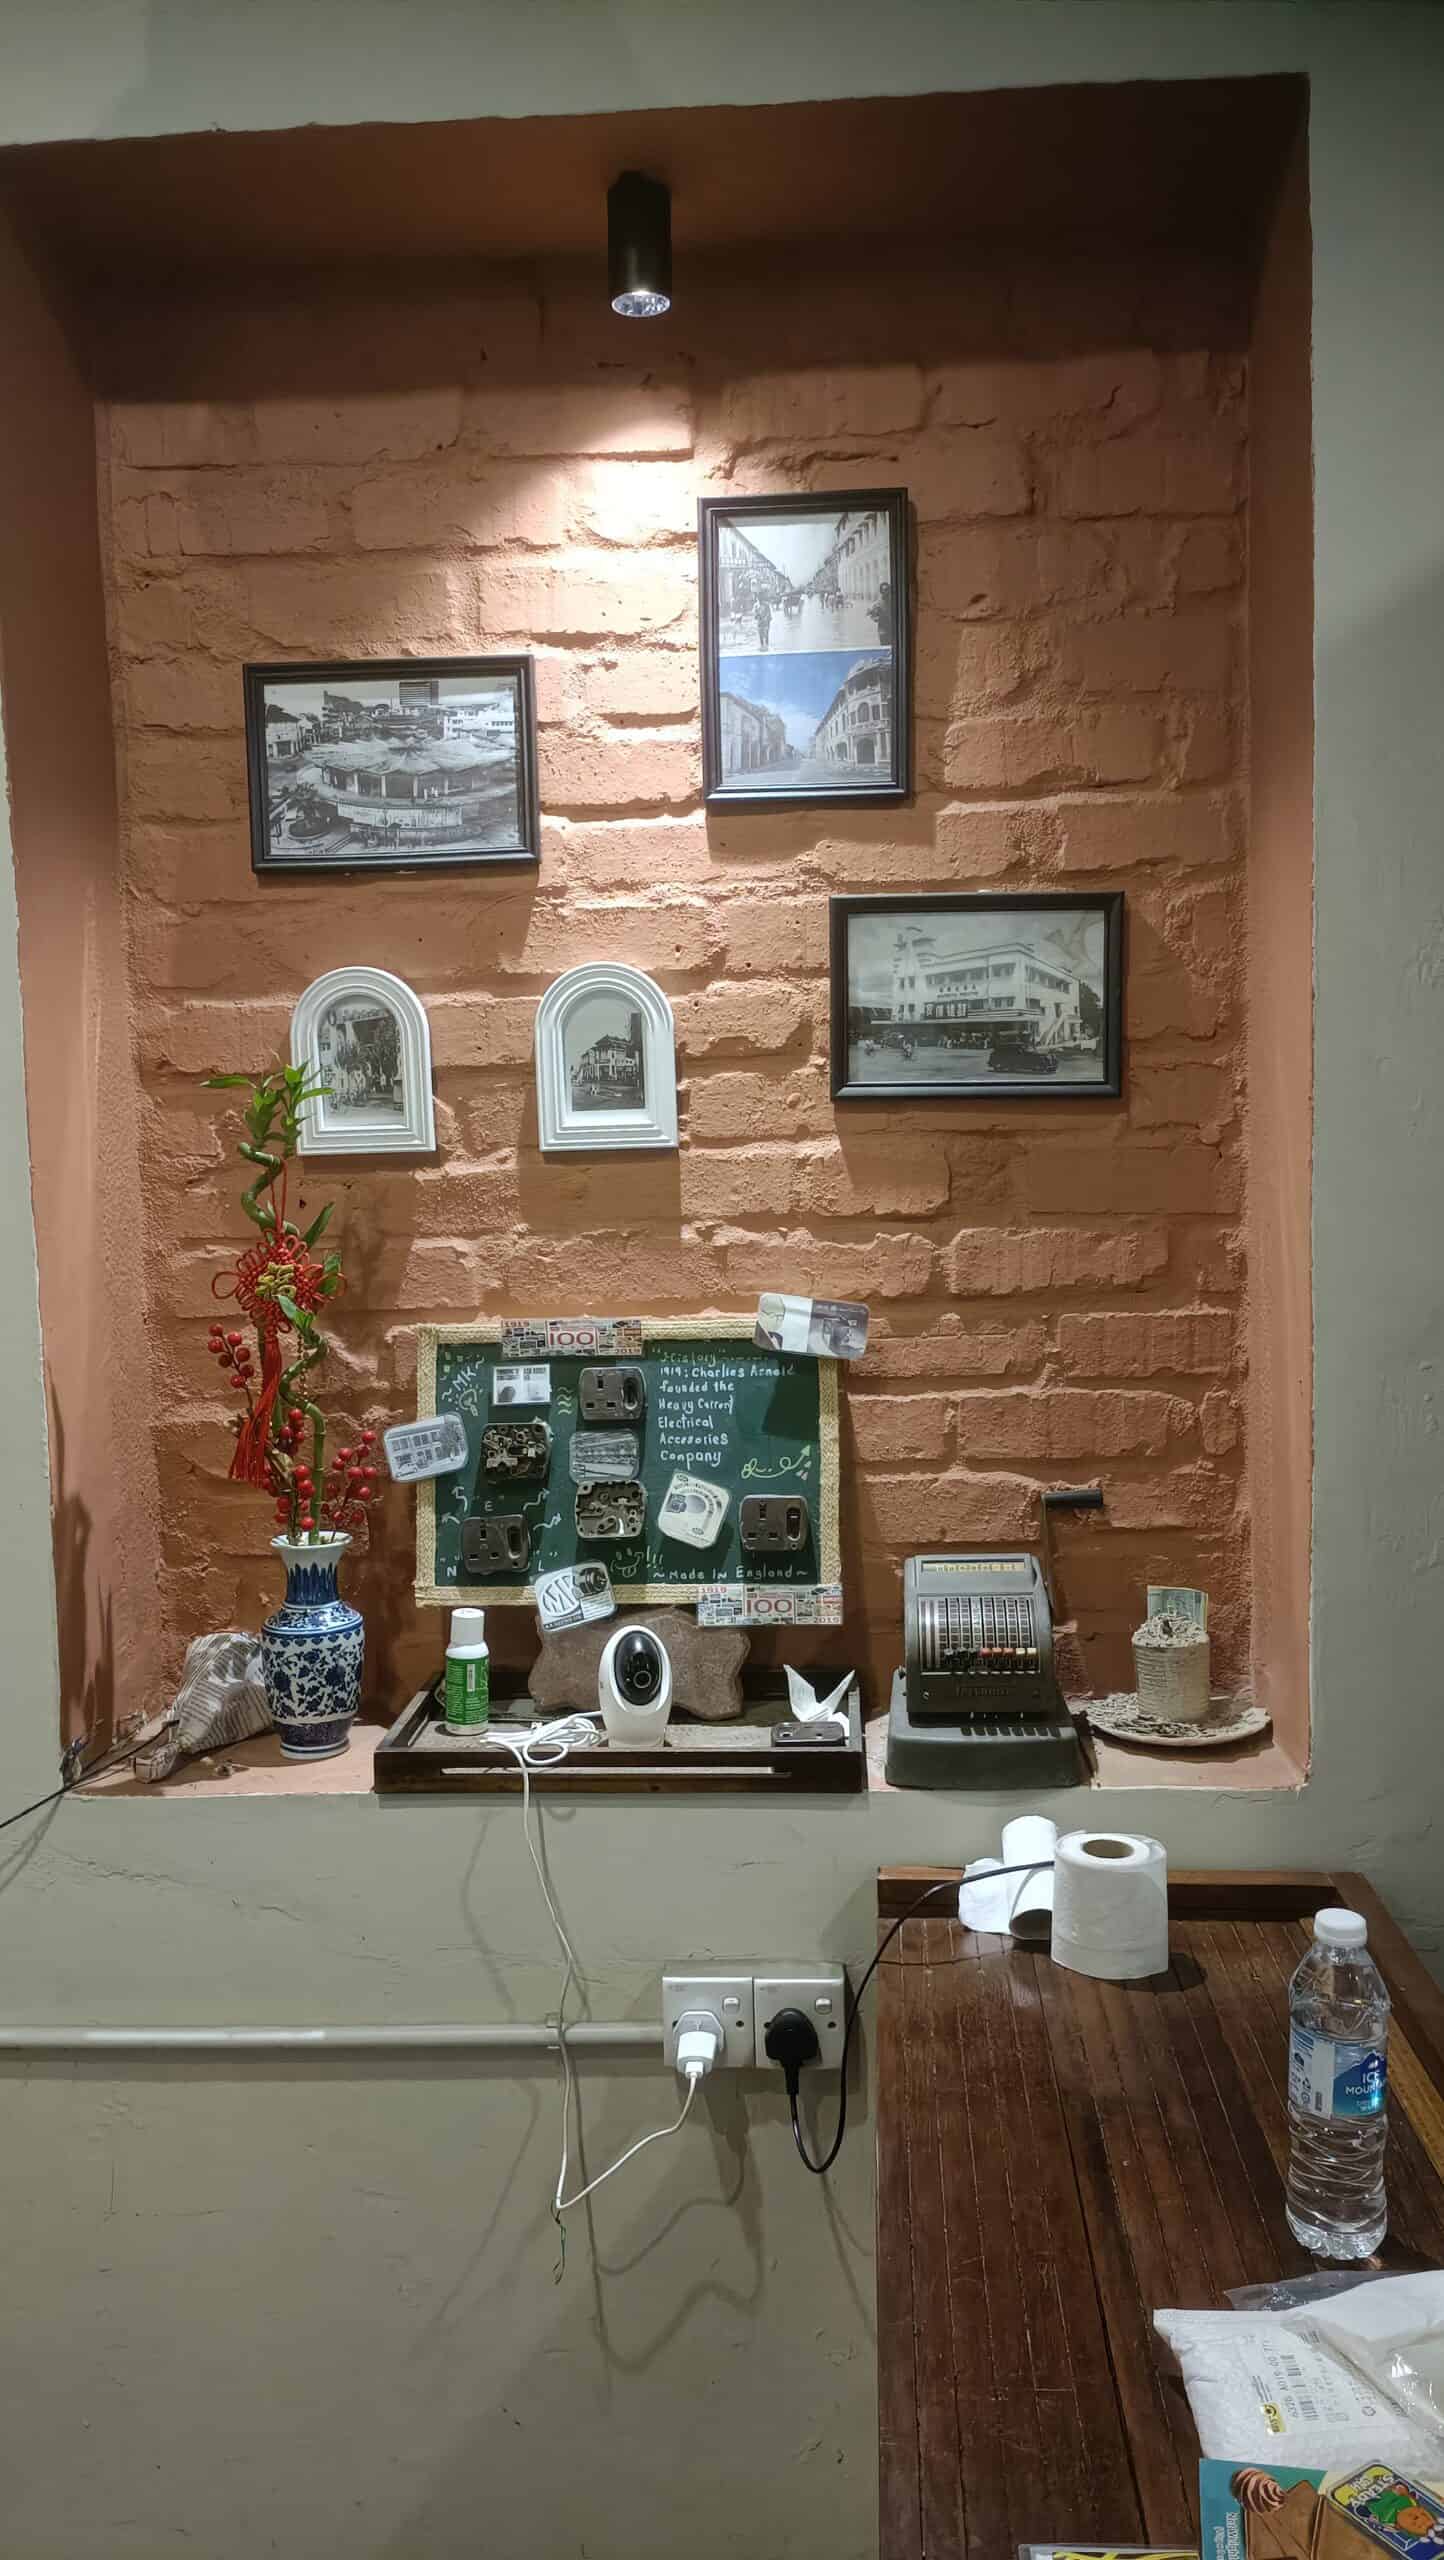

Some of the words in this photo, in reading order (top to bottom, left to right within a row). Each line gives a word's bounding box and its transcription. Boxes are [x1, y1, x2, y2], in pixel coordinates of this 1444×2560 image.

[549, 1331, 594, 1346] 100
[452, 1366, 477, 1391] MK
[659, 1380, 708, 1393] founded
[714, 1380, 735, 1392] the
[658, 1397, 694, 1414] Heavy
[658, 1413, 714, 1429] Electrical
[669, 1568, 705, 1580] Made
[736, 1564, 793, 1580] England
[746, 1599, 793, 1614] 100
